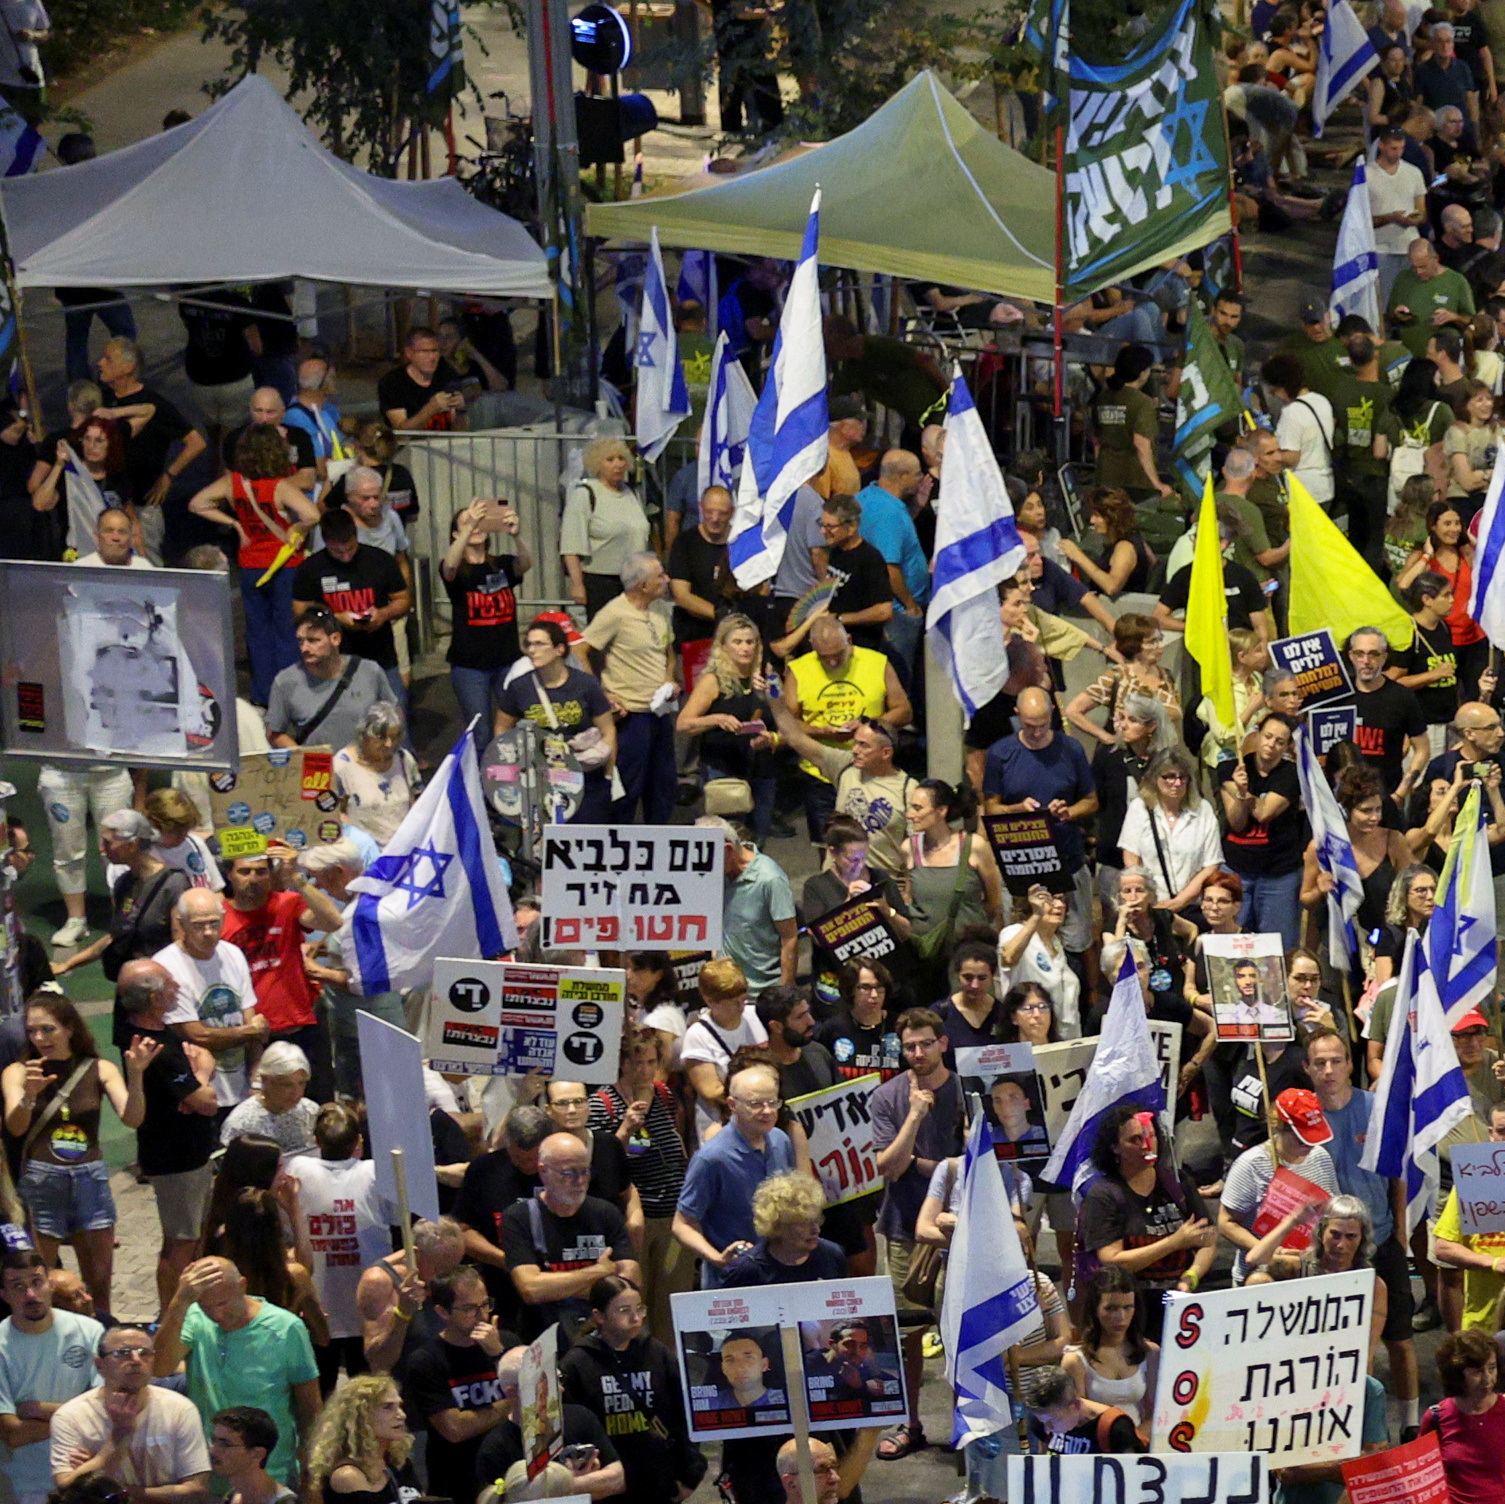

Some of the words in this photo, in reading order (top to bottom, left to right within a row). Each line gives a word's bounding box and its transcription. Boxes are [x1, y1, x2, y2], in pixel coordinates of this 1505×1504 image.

[566, 882, 681, 906] מחזיר
[543, 914, 707, 948] חטופים!
[1224, 1294, 1366, 1345] הממשלה
